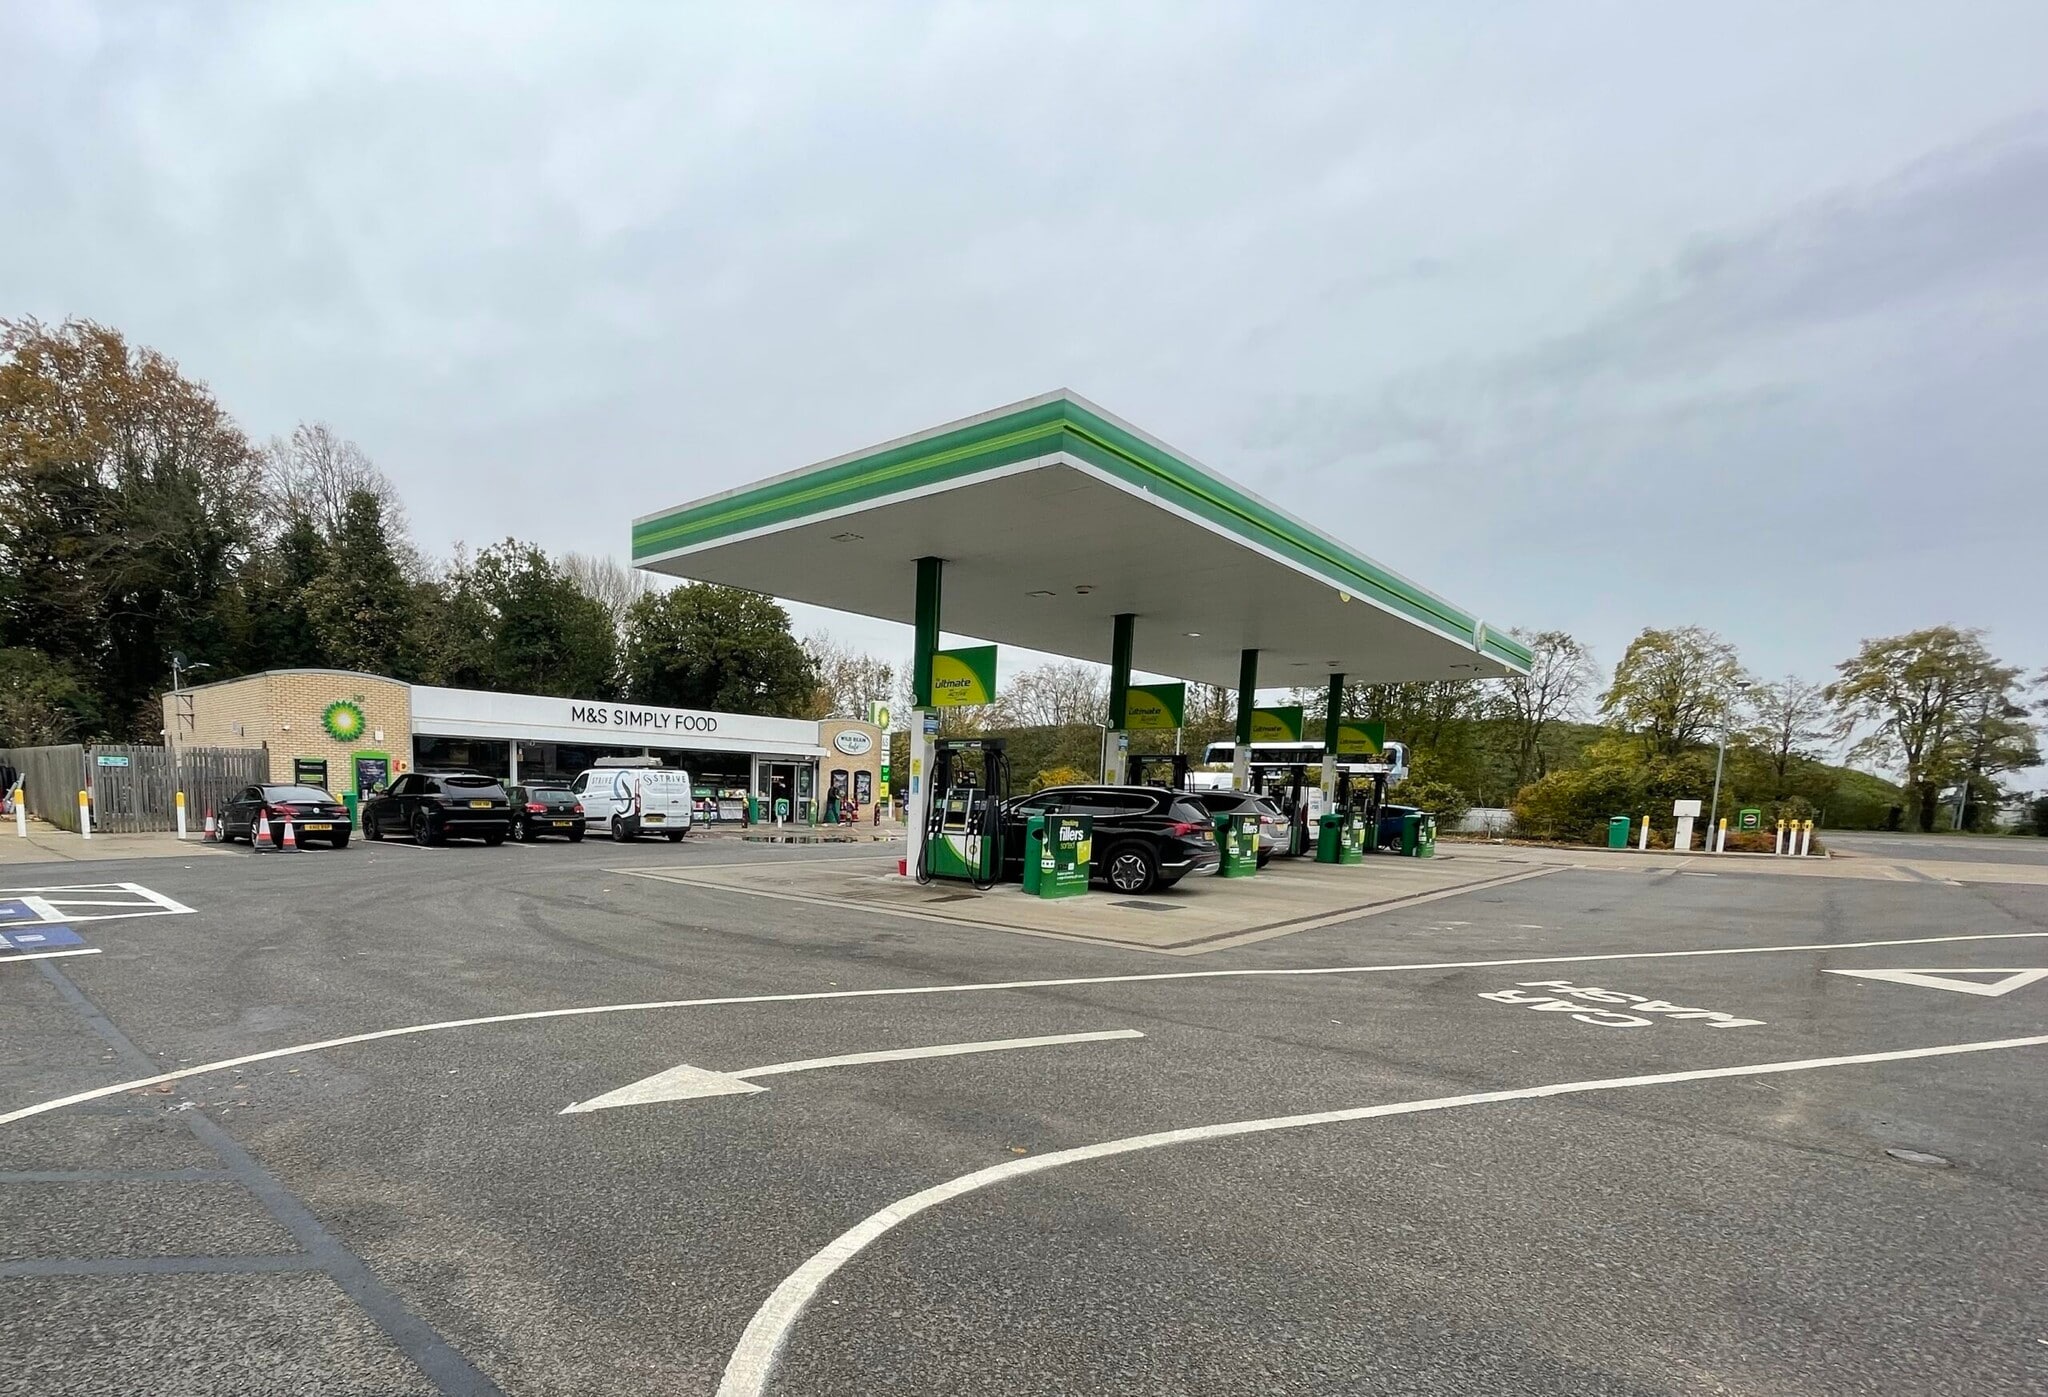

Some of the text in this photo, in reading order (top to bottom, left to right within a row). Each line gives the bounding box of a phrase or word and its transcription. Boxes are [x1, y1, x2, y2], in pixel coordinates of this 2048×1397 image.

[571, 706, 718, 732] M&S SIMPLY FOOD
[591, 776, 613, 785] STRIVE
[653, 774, 686, 783] STRIVE
[1059, 826, 1084, 841] fillers
